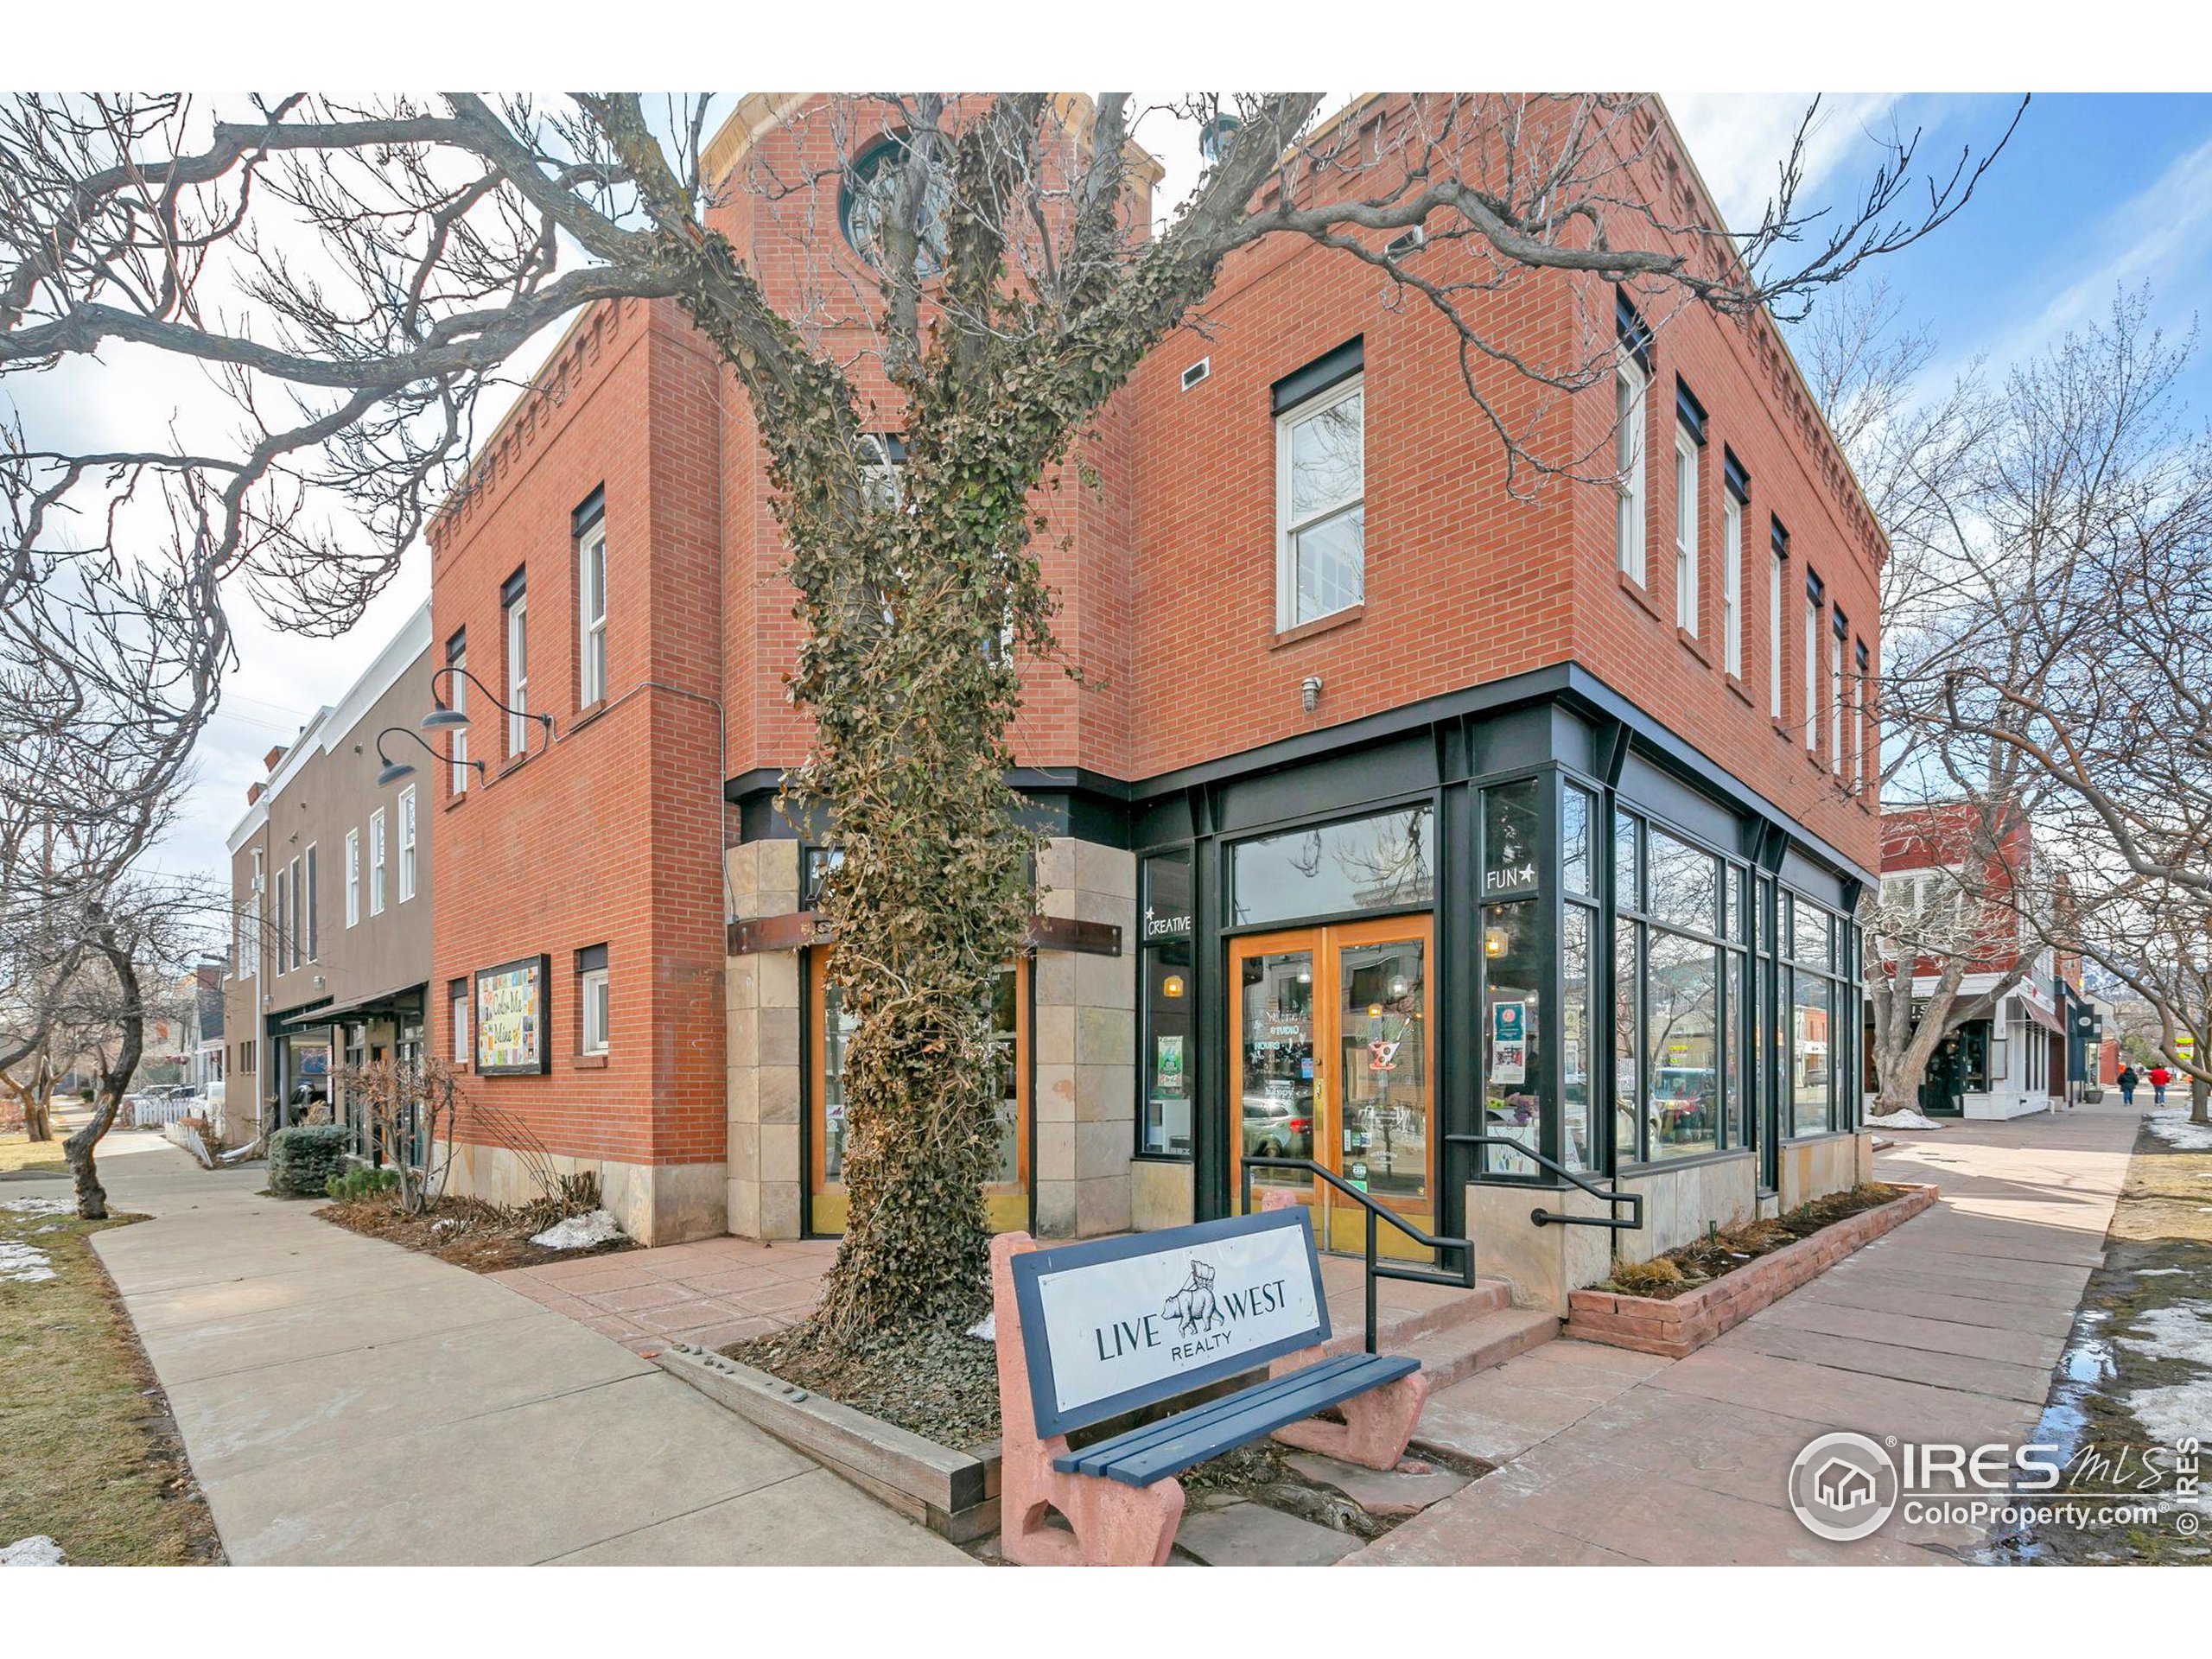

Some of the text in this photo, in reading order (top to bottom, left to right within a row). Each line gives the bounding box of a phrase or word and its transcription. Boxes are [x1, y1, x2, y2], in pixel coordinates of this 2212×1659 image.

[1486, 867, 1517, 889] FUN
[1147, 916, 1192, 936] CREATIVE
[511, 990, 523, 1014] Me
[493, 1023, 512, 1044] Mine
[1269, 1025, 1300, 1036] STUDIO
[1254, 1041, 1281, 1051] HOURS
[1095, 1279, 1287, 1362] LIVE WEST
[1171, 1330, 1234, 1363] REALTY
